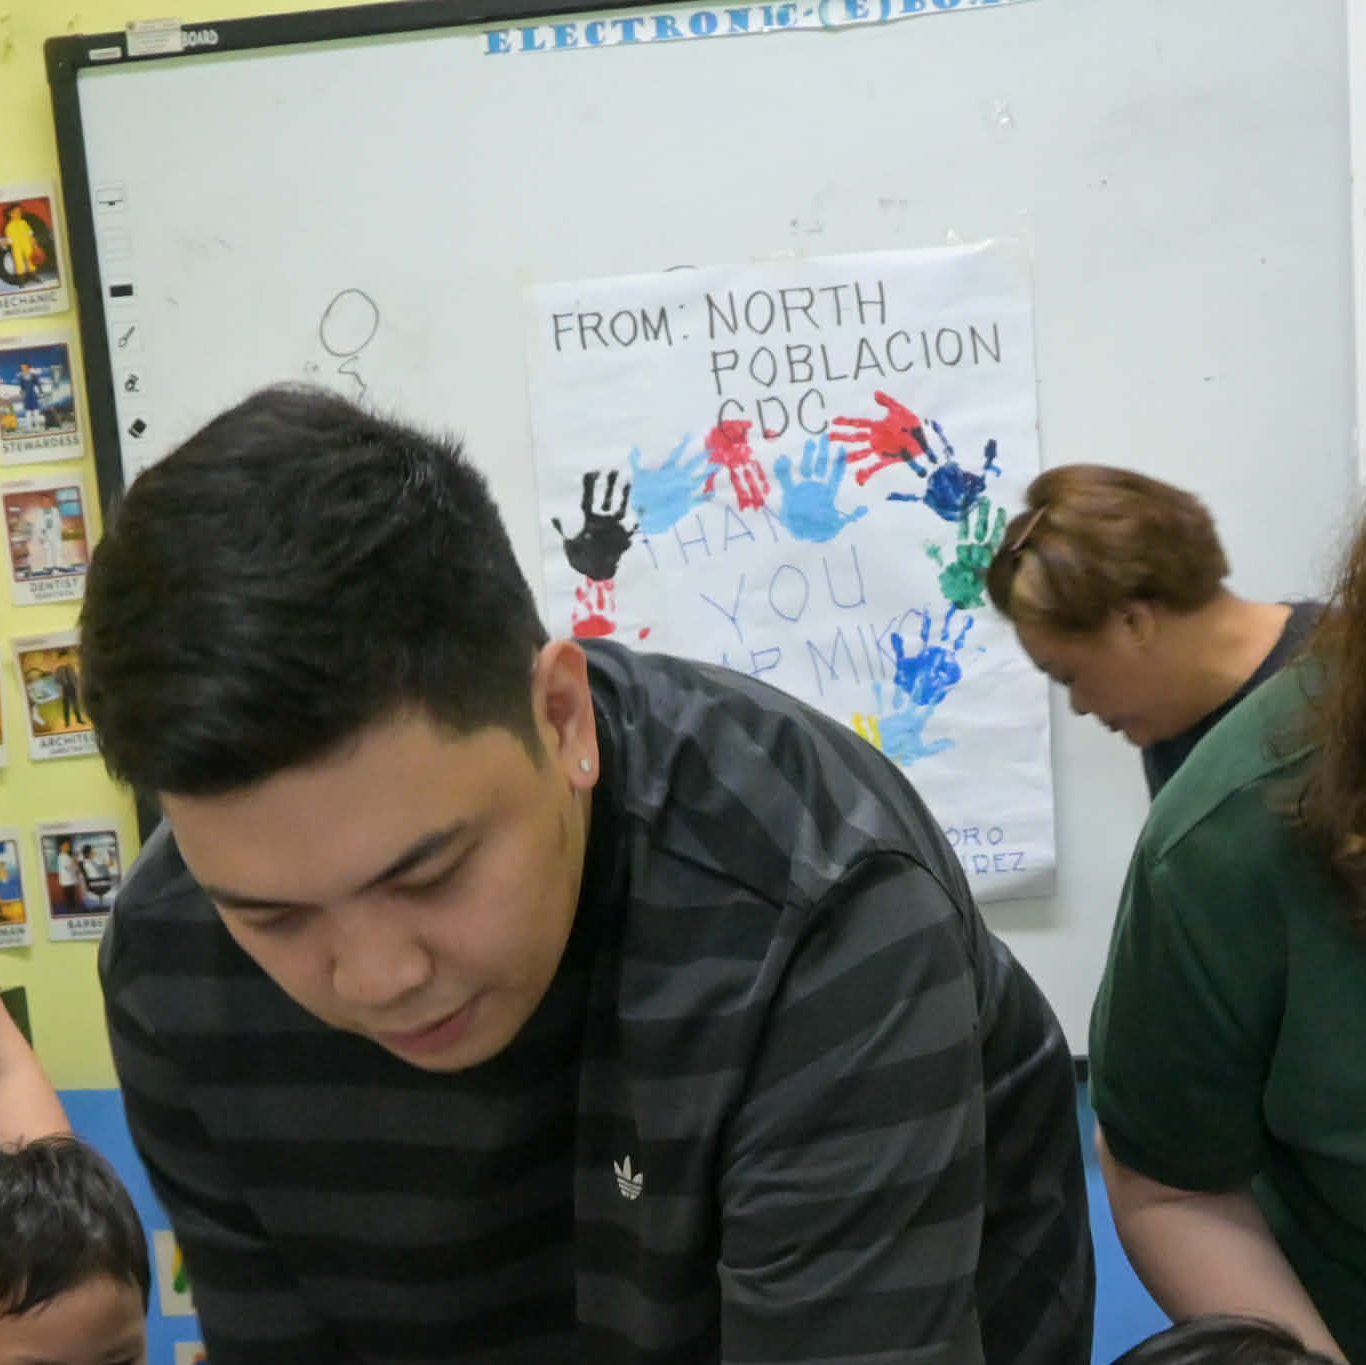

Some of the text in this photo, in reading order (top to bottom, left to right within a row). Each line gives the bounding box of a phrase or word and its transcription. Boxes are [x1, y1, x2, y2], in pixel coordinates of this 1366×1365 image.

[552, 280, 888, 352] FROM: NORTH
[710, 322, 1002, 396] POBLACION
[699, 544, 866, 643] YOU
